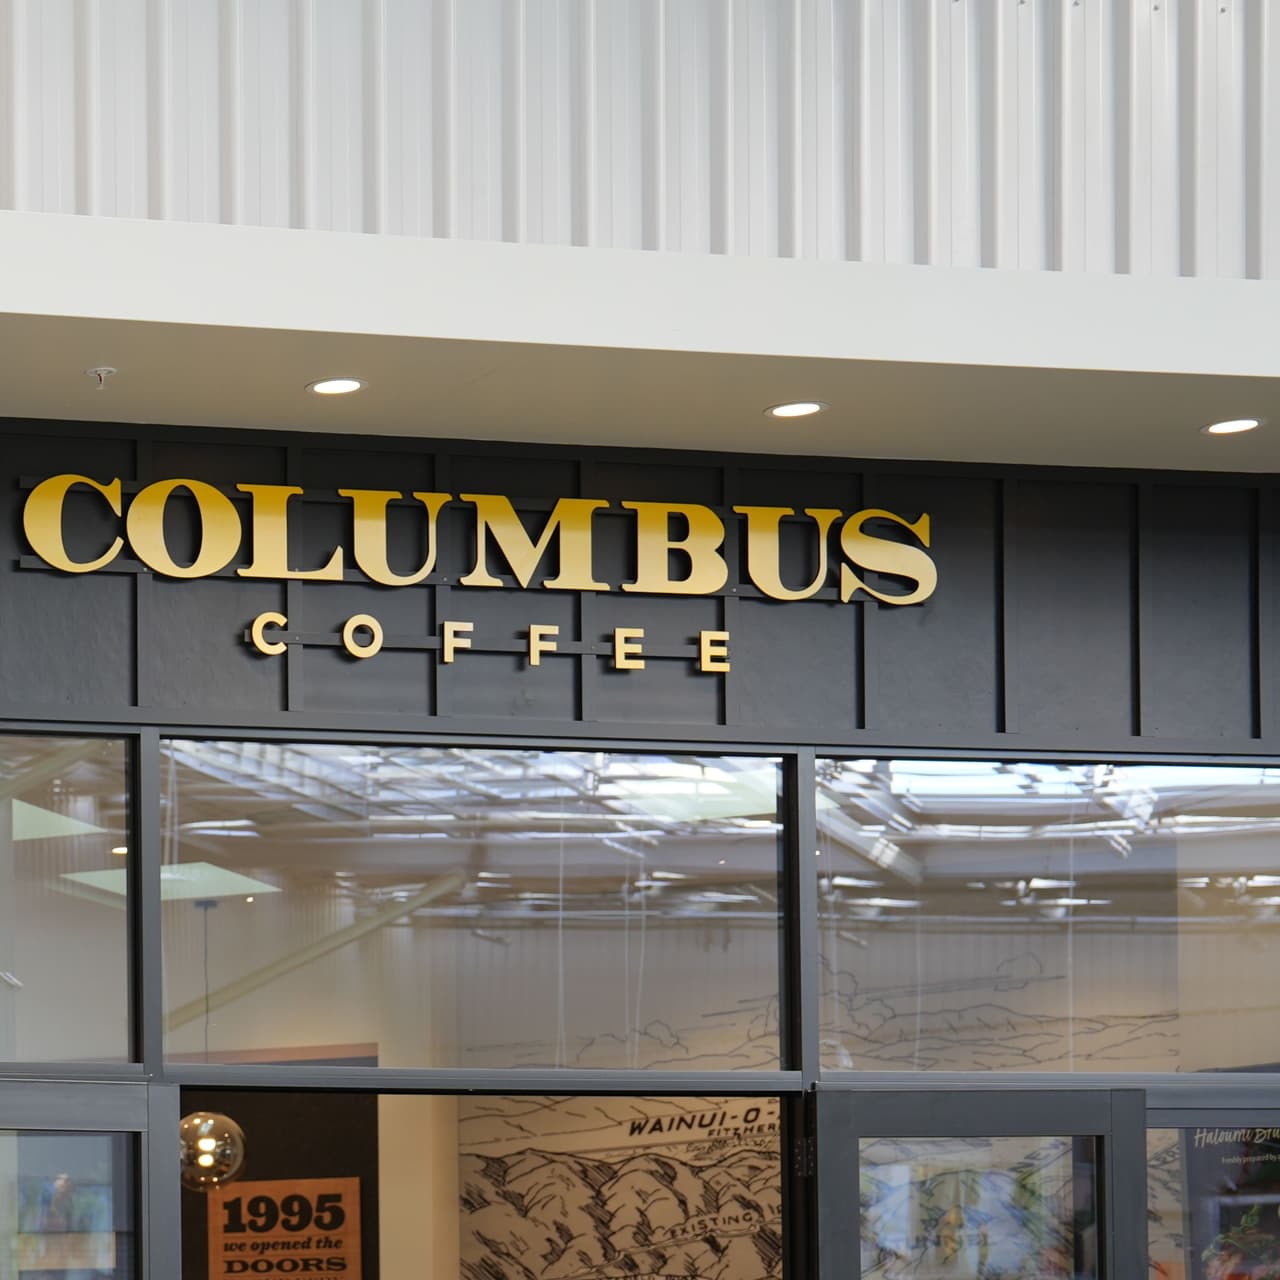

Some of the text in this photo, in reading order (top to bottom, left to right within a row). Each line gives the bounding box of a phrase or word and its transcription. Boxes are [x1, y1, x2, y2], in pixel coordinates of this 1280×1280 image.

[23, 474, 938, 606] COLUMBUS
[251, 611, 731, 673] COFFEE
[629, 1107, 780, 1136] WAINUI-O-
[223, 1194, 345, 1233] 1995
[224, 1236, 343, 1254] we opened the
[224, 1257, 347, 1274] DOORS
